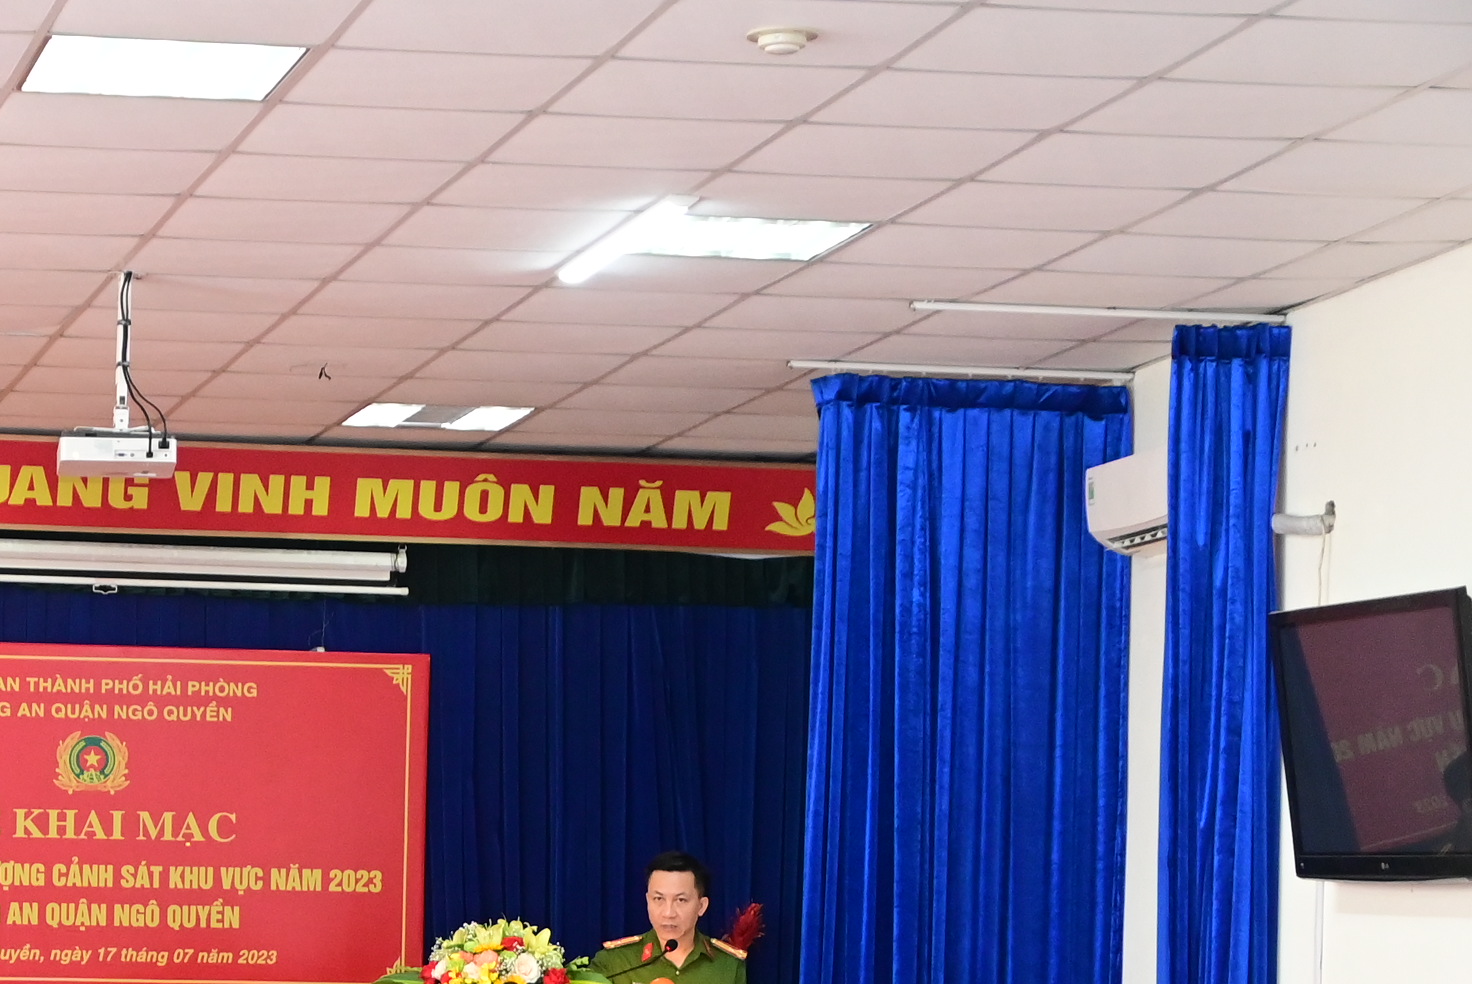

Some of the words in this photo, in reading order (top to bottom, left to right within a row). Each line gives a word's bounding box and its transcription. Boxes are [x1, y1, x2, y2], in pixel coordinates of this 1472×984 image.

[174, 471, 331, 516] VINH
[354, 473, 555, 524] MUÔN
[578, 479, 731, 531] NĂM
[26, 674, 95, 694] THÀNH
[101, 674, 143, 695] PHỐ
[148, 674, 181, 696] HẢI
[187, 677, 258, 698] PHÒNG
[17, 702, 45, 718] AN
[51, 700, 108, 722] QUẬN
[114, 701, 158, 720] NGÔ
[163, 700, 233, 722] QUYỀN
[12, 808, 125, 840] KHAI
[136, 811, 238, 847] MẠC
[52, 856, 114, 888] CẢNH
[120, 859, 163, 889] SÁT
[169, 866, 214, 890] KHU
[218, 866, 264, 897] VỰC
[270, 863, 322, 892] NĂM
[328, 869, 382, 893] 2023
[6, 901, 39, 925] AN
[45, 898, 107, 931] QUẬN
[113, 899, 160, 928] NGÔ
[167, 898, 240, 931] QUYỀN
[50, 946, 92, 965] ngày
[97, 947, 117, 962] 17
[120, 947, 169, 966] tháng
[173, 948, 194, 963] 07
[197, 949, 233, 964] năm
[237, 949, 278, 965] 2023
